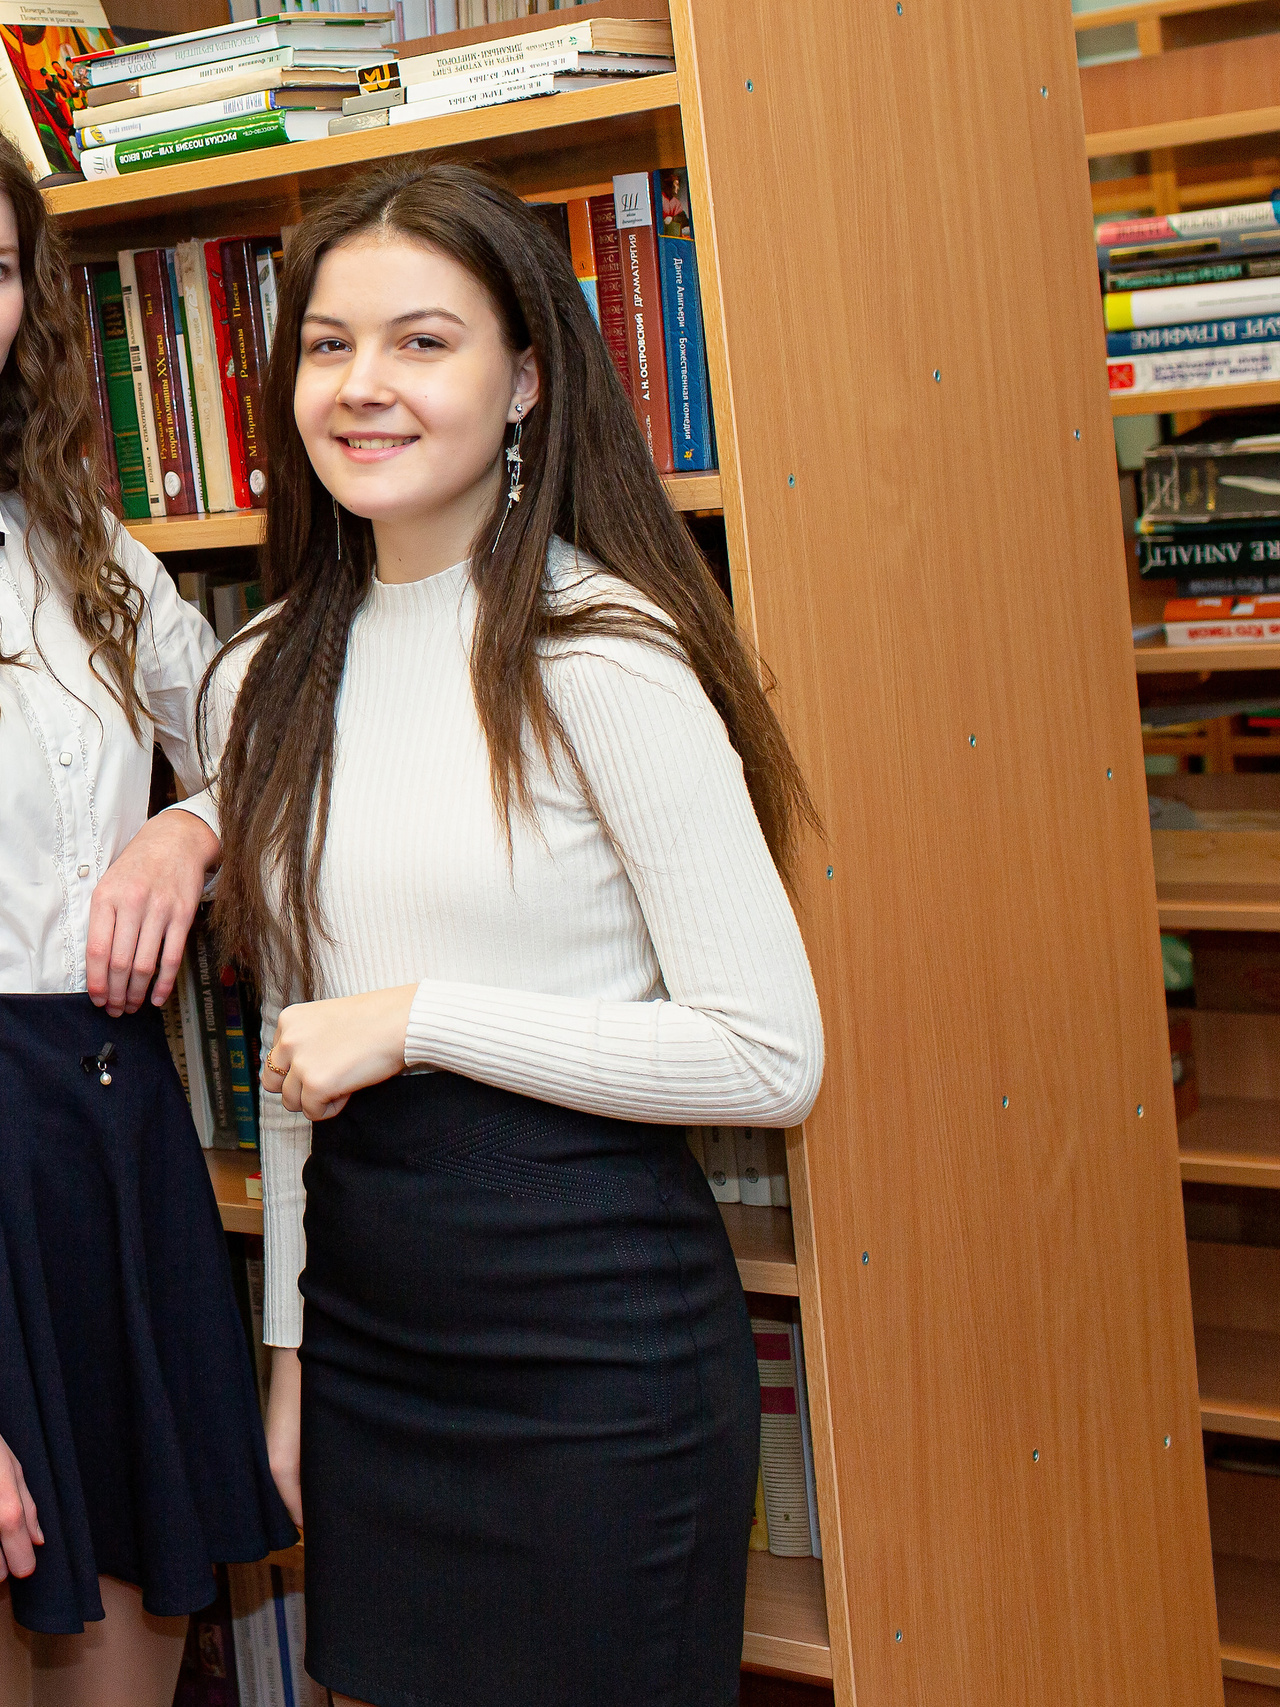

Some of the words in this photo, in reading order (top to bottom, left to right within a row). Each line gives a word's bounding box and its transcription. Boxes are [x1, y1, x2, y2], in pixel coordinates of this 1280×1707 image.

[175, 43, 215, 60] БРУШТЕЙН
[215, 35, 261, 52] АЛЕКСАНДРА
[128, 61, 157, 74] ДОРОГА
[454, 61, 483, 73] ХУТОРЕ
[485, 59, 495, 68] НА
[496, 53, 525, 66] ВЕЧЕРА
[200, 65, 234, 78] КОМЕДИИ
[469, 71, 499, 84] БУЛЬБА
[500, 67, 526, 78] ТАРАС
[243, 94, 263, 110] ИВАН
[448, 93, 478, 106] БУЛЬБА
[480, 89, 503, 100] ТАРАС
[223, 98, 244, 115] БУНИН
[176, 137, 205, 153] ПОЭЗИЯ
[205, 131, 238, 148] РУССКАЯ
[119, 151, 141, 165] ВЕКОВ
[628, 233, 644, 308] ДРАМАТУРГИЯ
[673, 258, 683, 284] Данте
[232, 282, 243, 318] Пьесы
[676, 284, 686, 328] Алигьери
[144, 301, 154, 318] Том
[1131, 323, 1218, 350] ГРАФИКЕ
[1222, 321, 1236, 341] В
[155, 334, 165, 356] века
[237, 328, 250, 379] Рассказы
[633, 312, 649, 378] ОСТРОВСКИЙ
[679, 337, 690, 401] Божественная
[163, 379, 175, 430] половины
[243, 394, 257, 440] Горький
[683, 401, 692, 440] комедия
[153, 421, 168, 461] Русская
[167, 431, 178, 460] второй
[249, 442, 258, 458] М.
[1152, 541, 1243, 567] ANHALT
[202, 988, 217, 1032] ГОСПОДА
